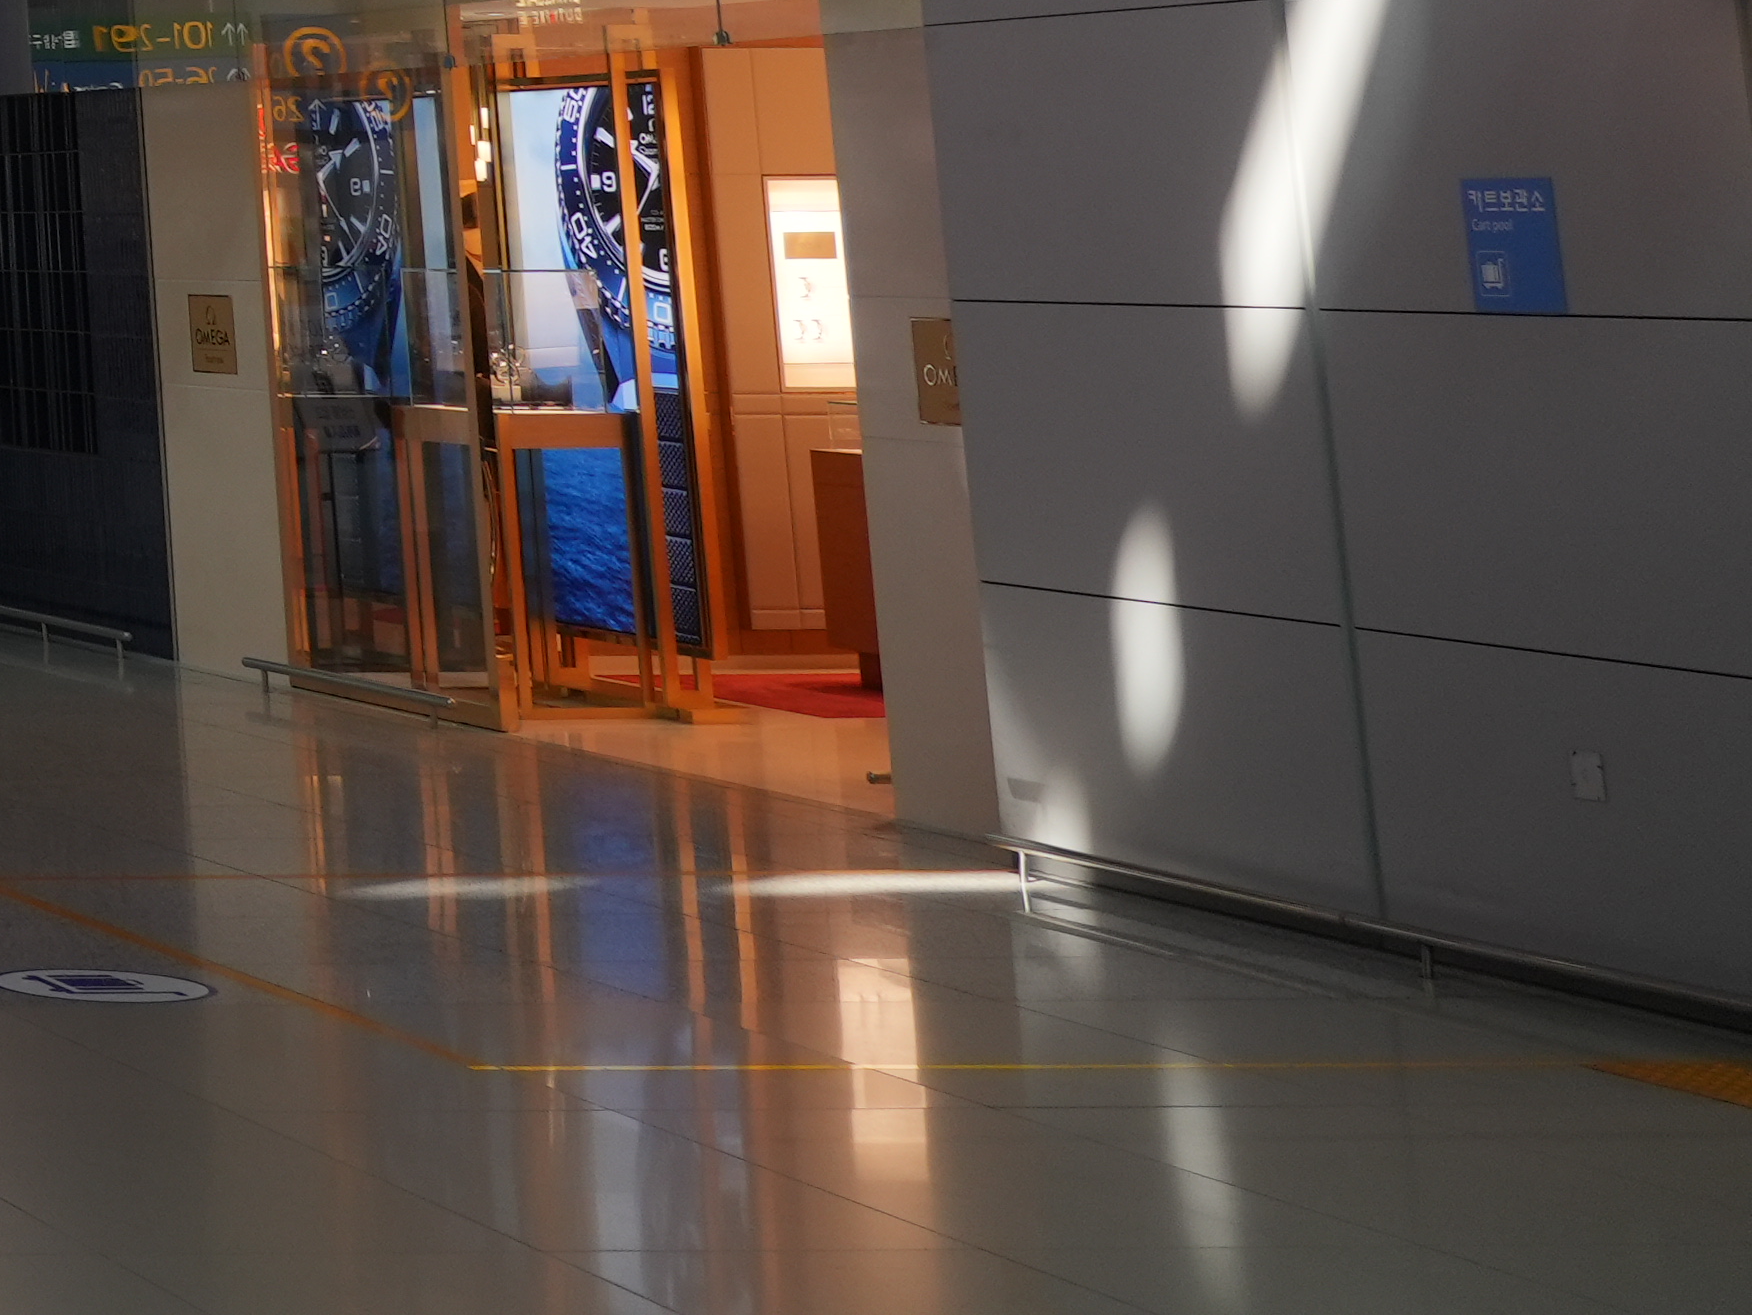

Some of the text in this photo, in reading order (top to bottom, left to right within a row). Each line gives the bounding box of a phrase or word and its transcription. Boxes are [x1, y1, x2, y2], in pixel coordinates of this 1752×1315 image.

[1467, 188, 1546, 213] 카트보관소
[1472, 218, 1513, 234] Cart pool
[195, 327, 231, 346] OMEGA
